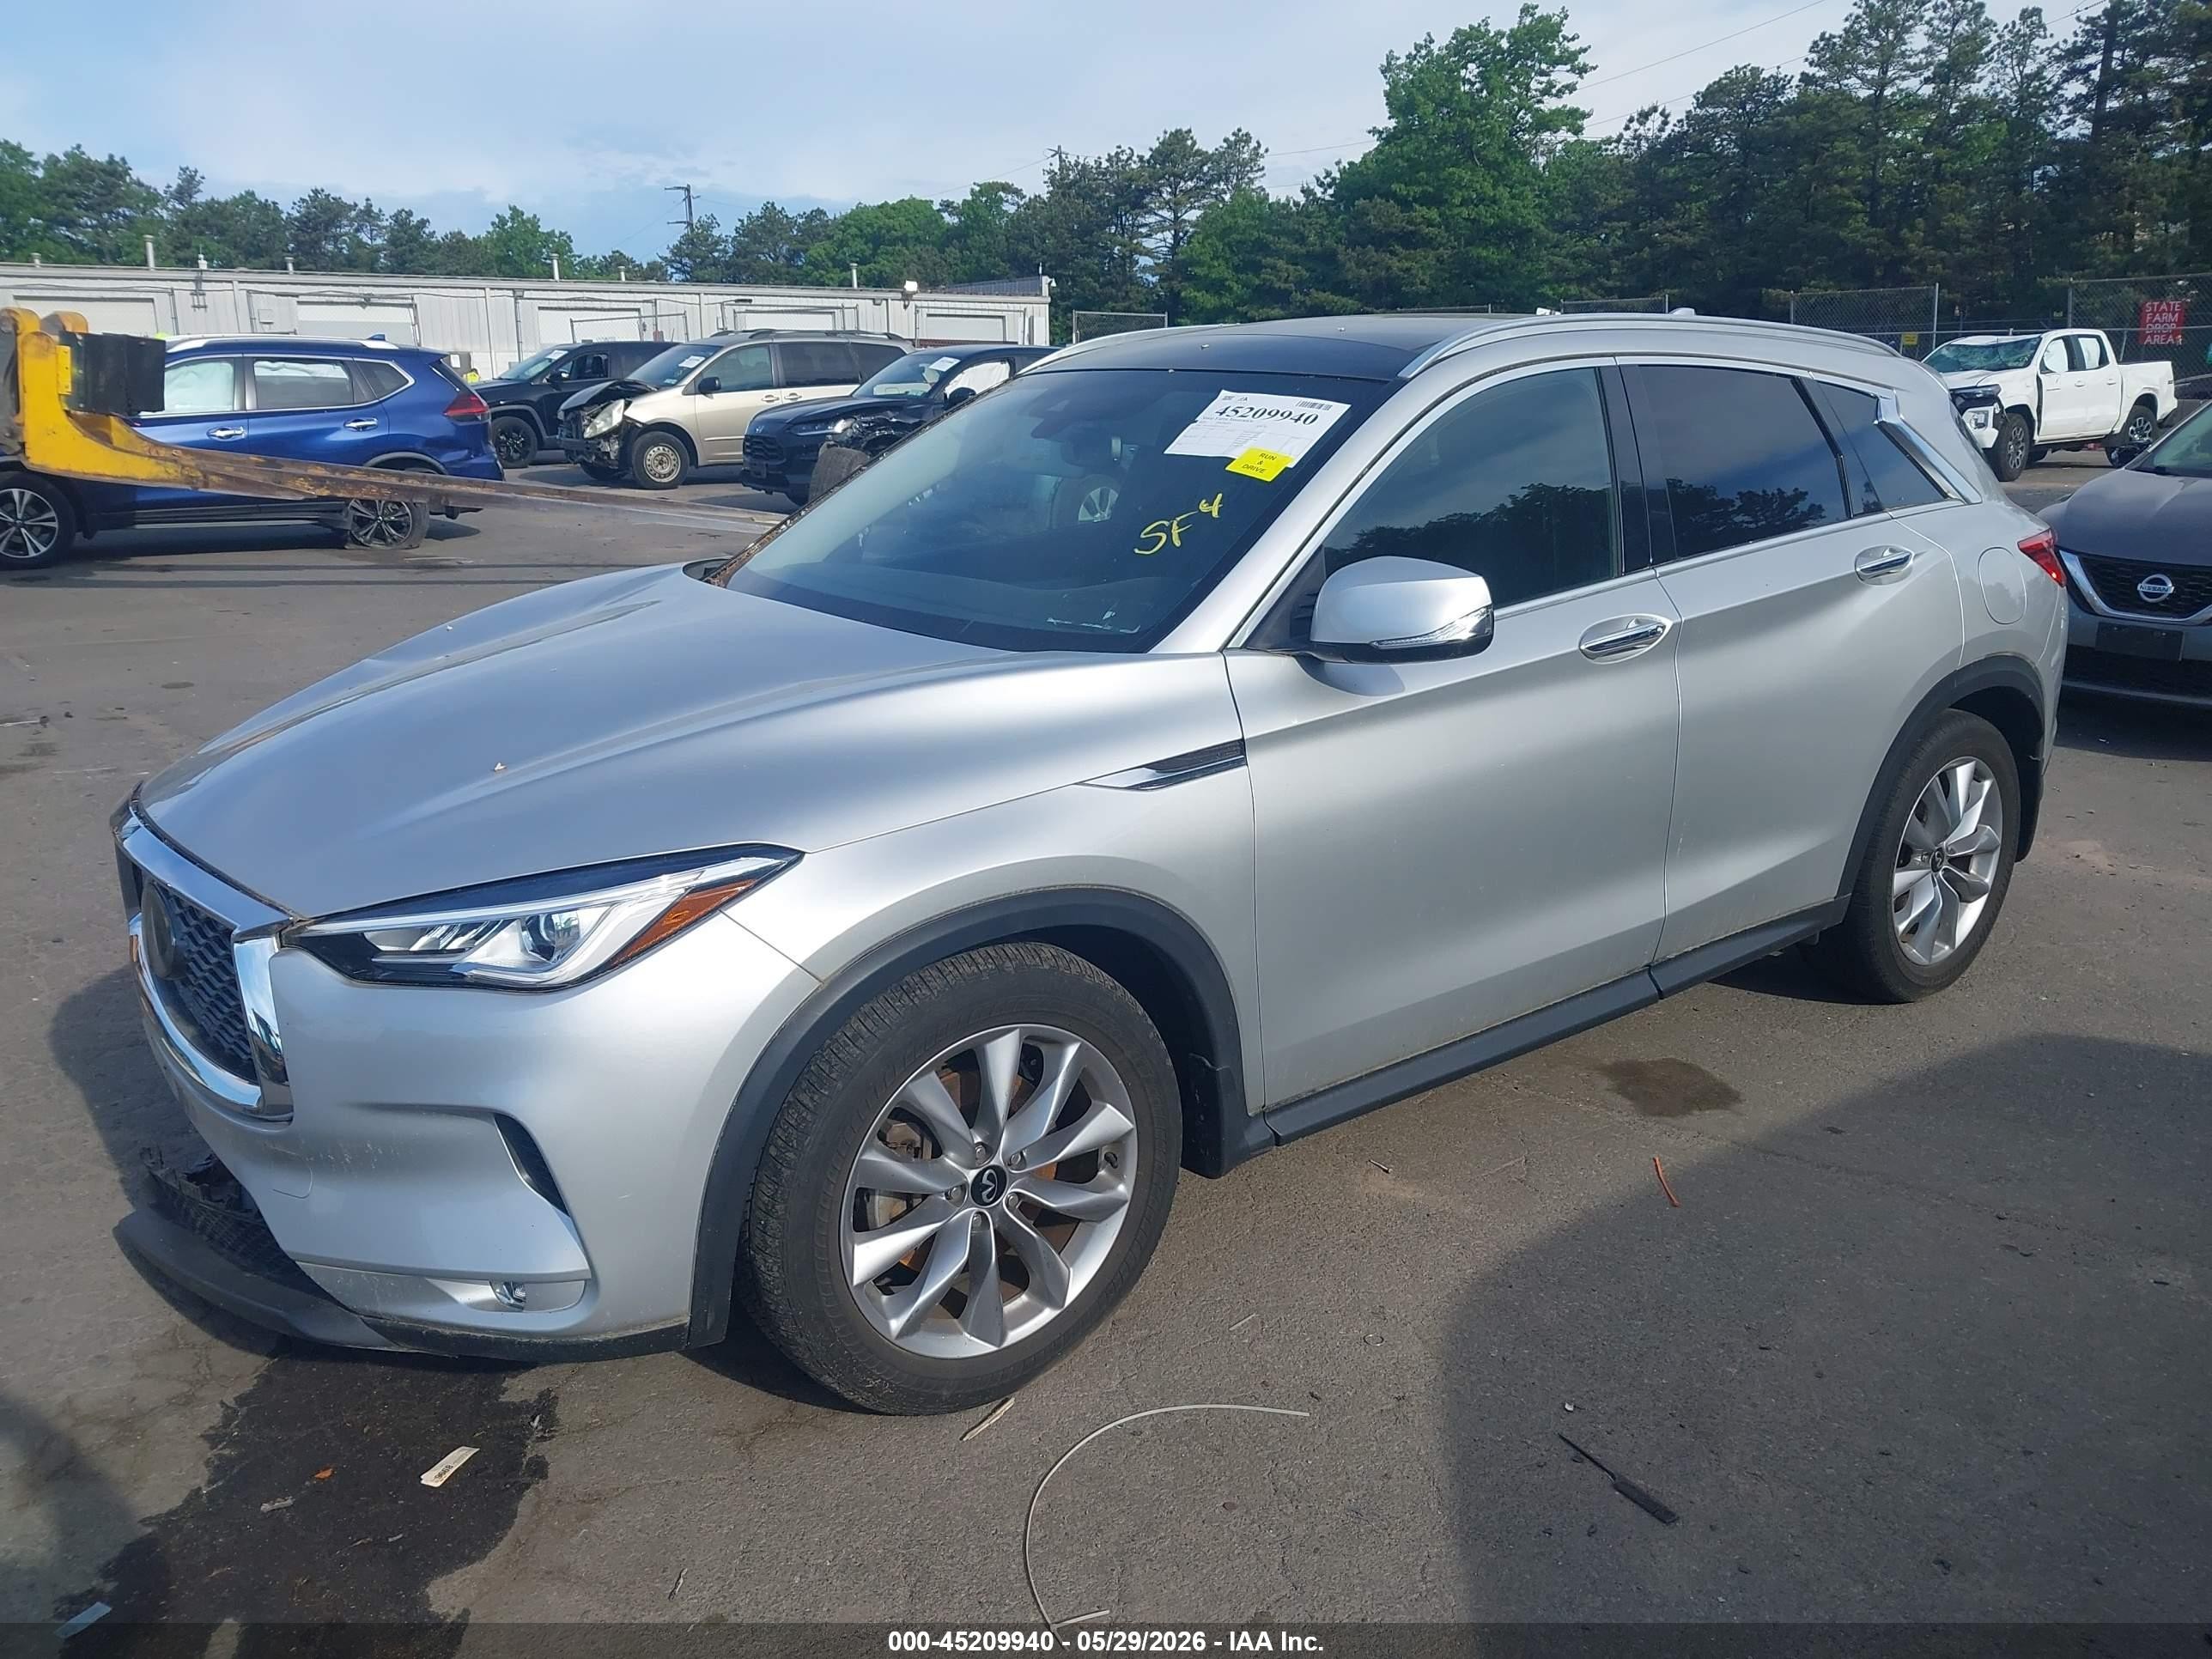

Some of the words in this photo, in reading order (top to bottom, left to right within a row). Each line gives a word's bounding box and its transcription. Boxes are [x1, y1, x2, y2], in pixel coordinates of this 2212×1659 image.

[2145, 301, 2182, 313] STATE
[2146, 313, 2179, 323] FARM
[2145, 323, 2177, 334] DROP
[2143, 334, 2175, 345] AREA
[1215, 405, 1319, 425] 45209940
[1259, 453, 1277, 461] RUN
[1242, 464, 1267, 474] DRIVE
[2139, 584, 2169, 592] NISSAN
